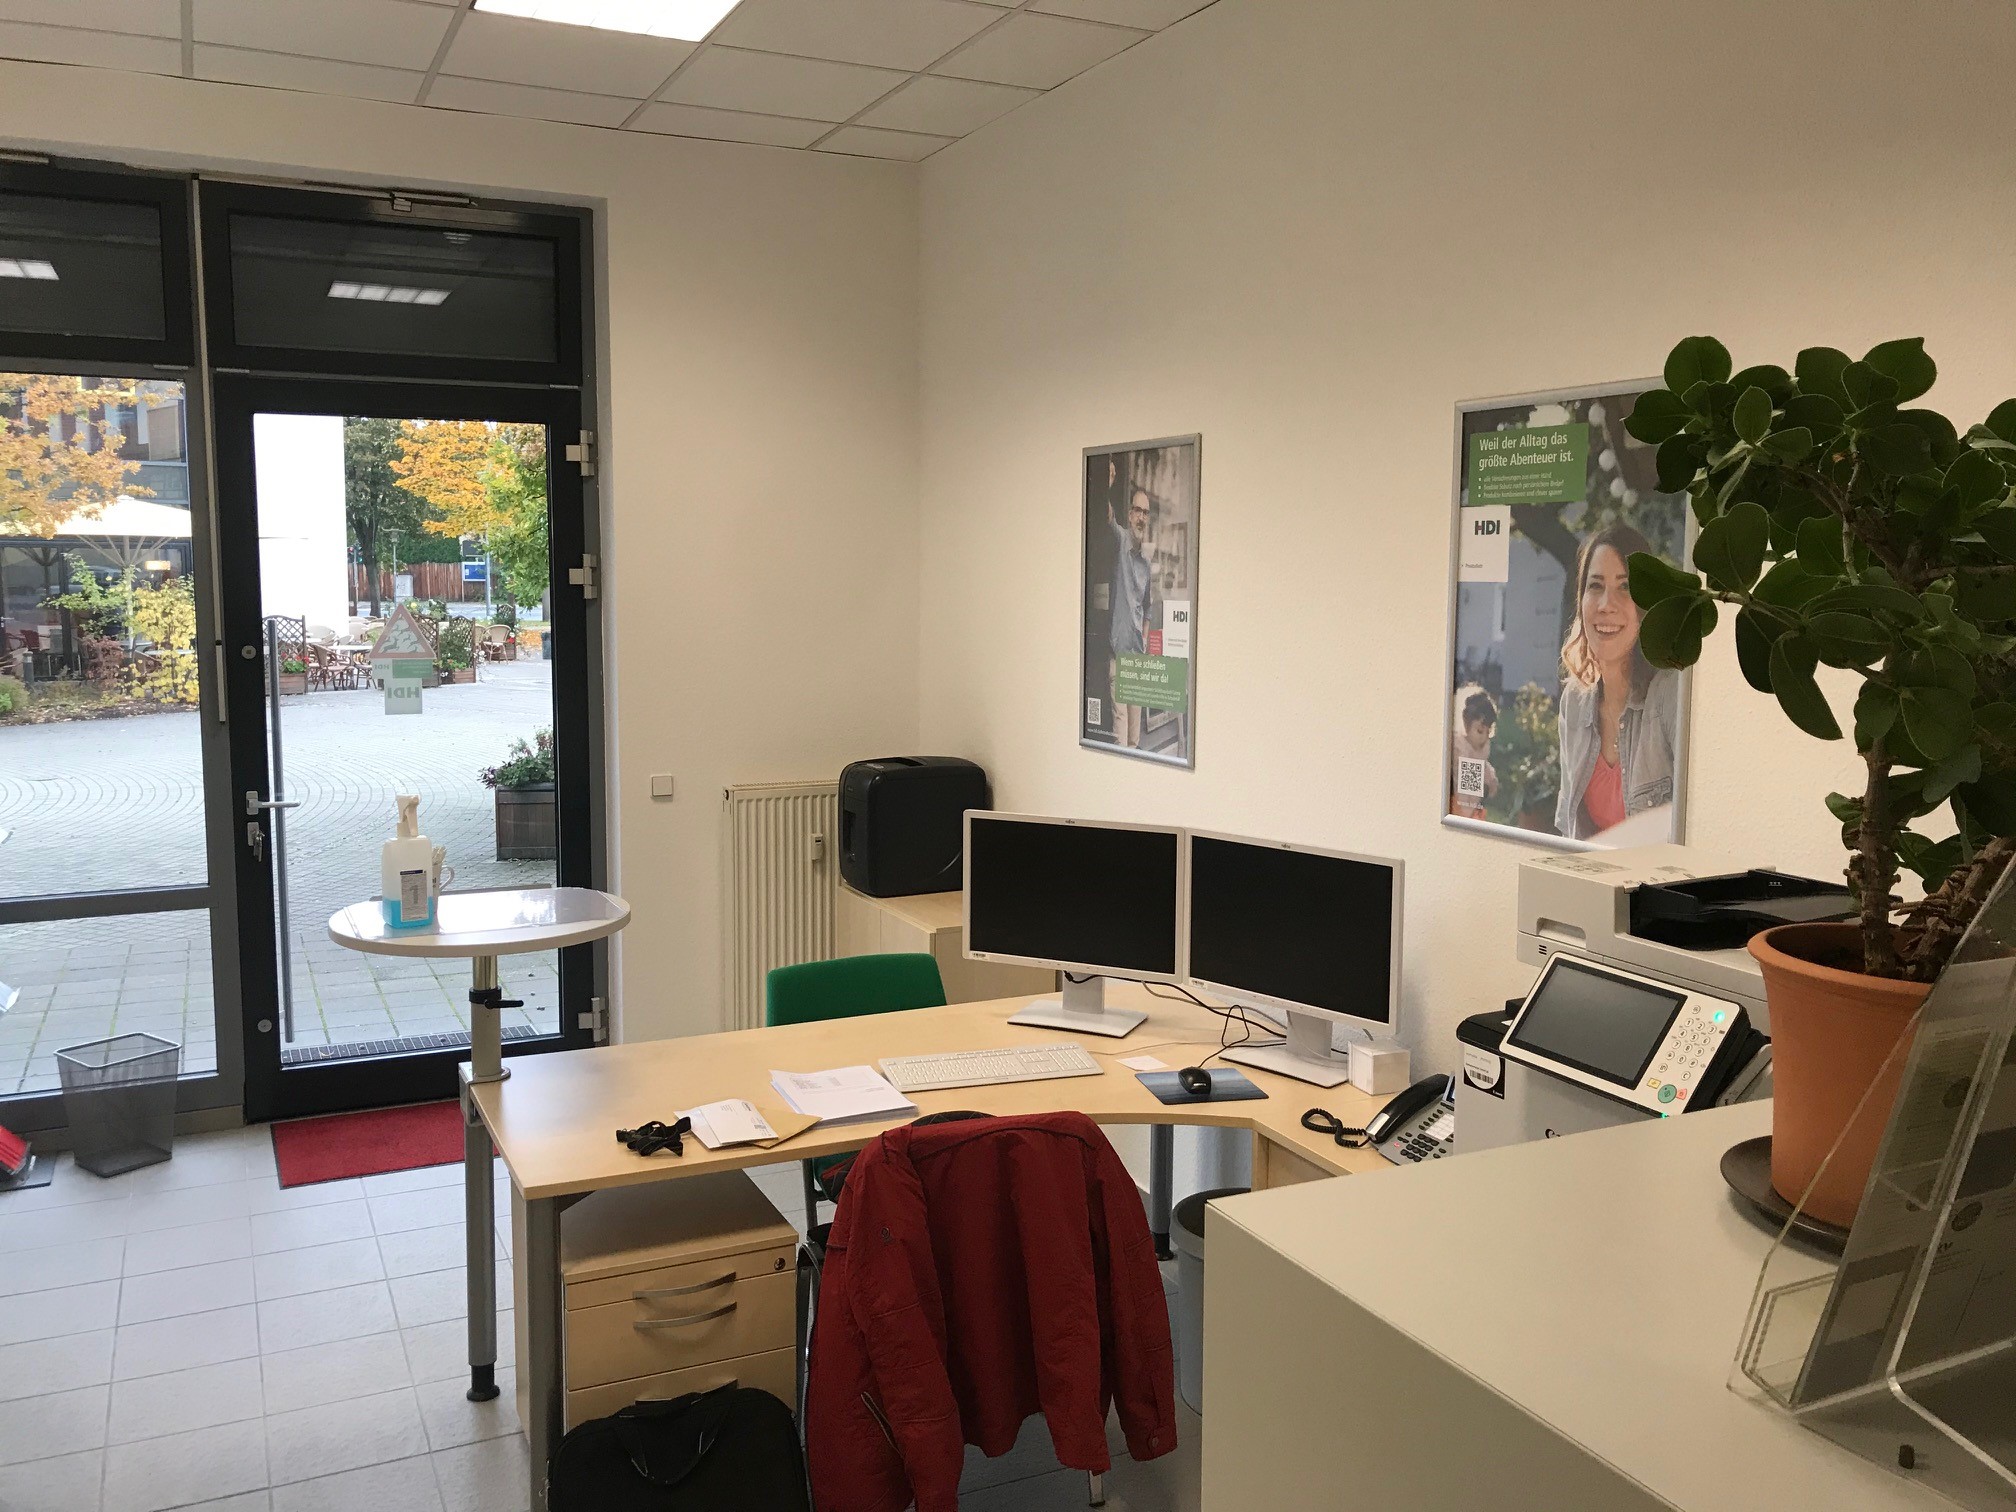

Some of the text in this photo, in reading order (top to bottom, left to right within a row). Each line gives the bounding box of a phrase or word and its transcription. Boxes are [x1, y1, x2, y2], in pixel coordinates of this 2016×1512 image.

[1479, 432, 1568, 451] Weil der Alltag das
[1479, 450, 1574, 471] größte Abenteuer ist.
[1474, 520, 1501, 535] HDI
[1173, 610, 1188, 622] HDI
[1120, 657, 1134, 667] Wenn
[1134, 659, 1142, 668] Sie
[1140, 671, 1150, 681] sind
[1150, 672, 1160, 682] wir
